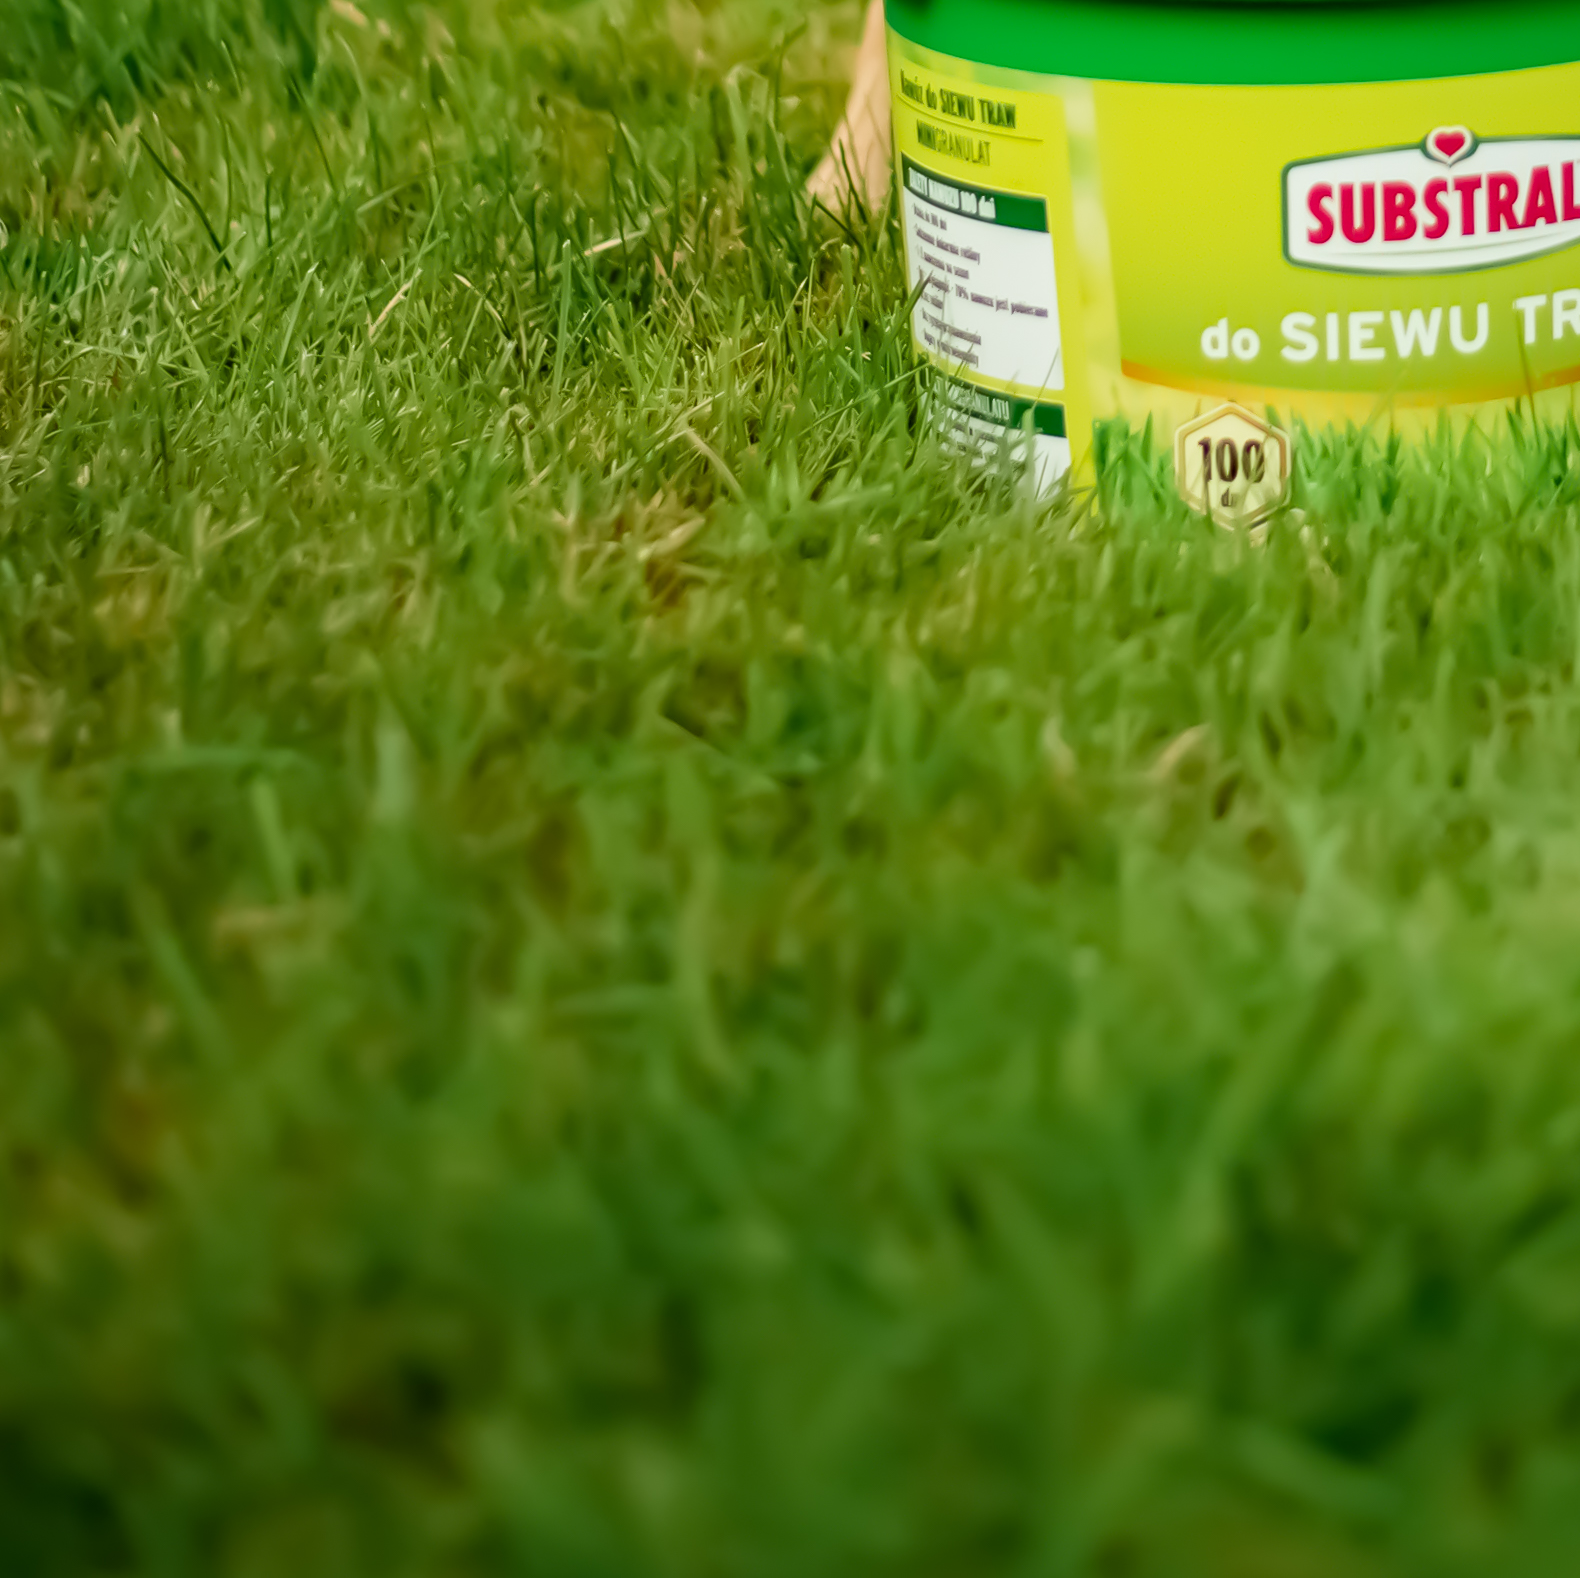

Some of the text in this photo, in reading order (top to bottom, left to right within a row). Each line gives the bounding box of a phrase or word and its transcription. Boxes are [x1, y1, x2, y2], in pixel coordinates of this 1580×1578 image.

[1200, 316, 1261, 360] do
[1280, 302, 1490, 363] SIEWU
[1197, 436, 1266, 484] 100
